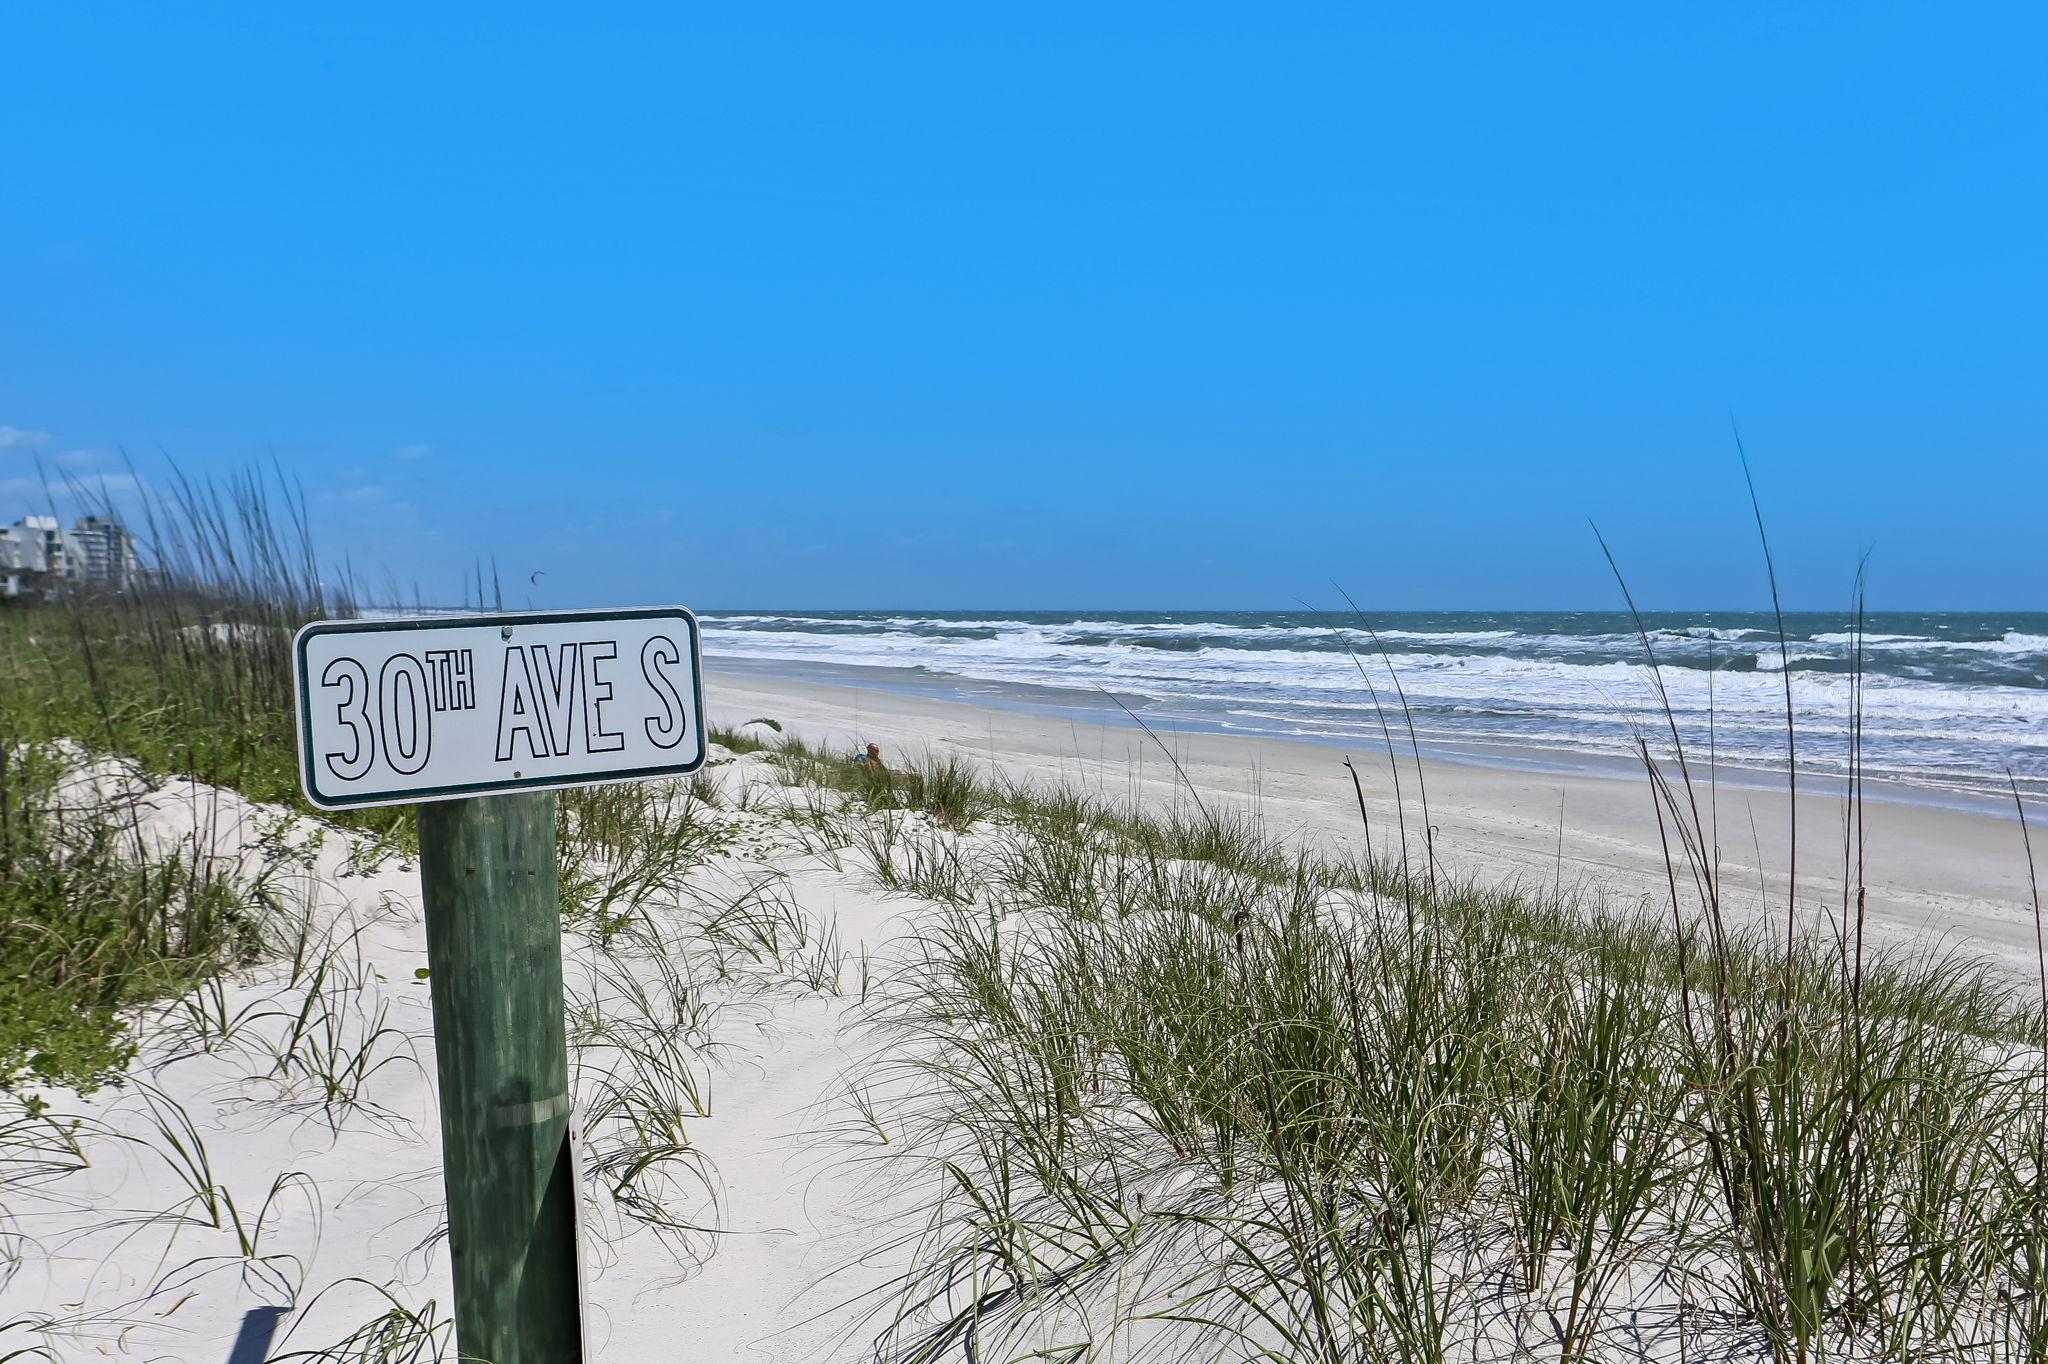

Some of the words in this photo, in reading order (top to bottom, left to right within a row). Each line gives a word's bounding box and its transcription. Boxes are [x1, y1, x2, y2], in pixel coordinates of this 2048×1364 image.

[321, 649, 476, 781] 30TH
[495, 641, 625, 762] AVE
[641, 635, 686, 749] S
